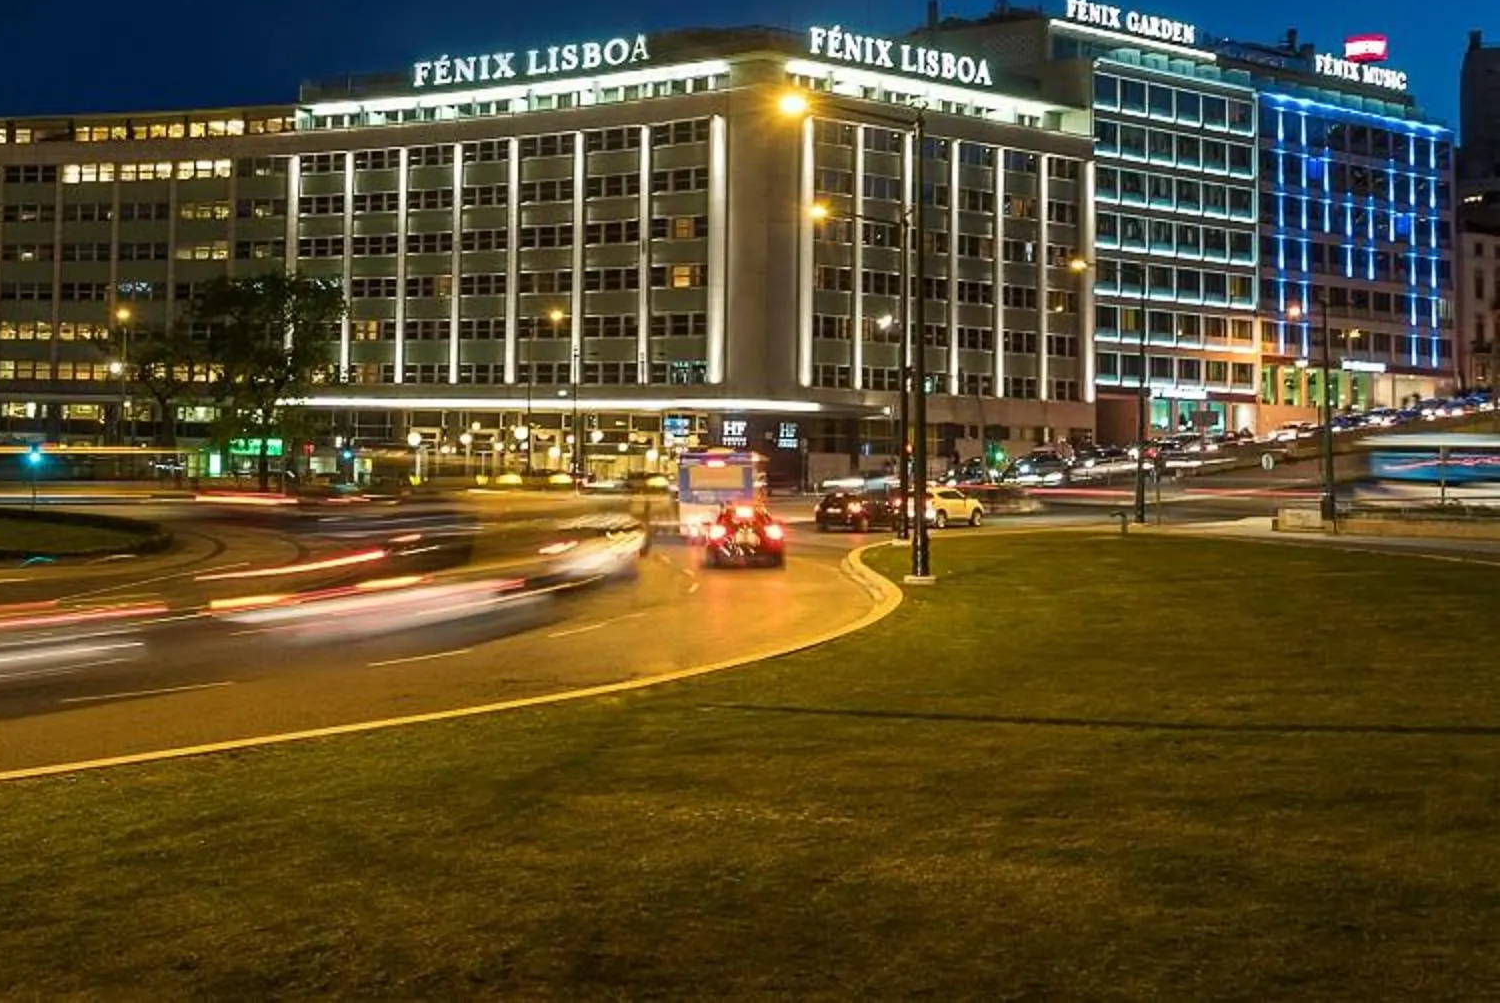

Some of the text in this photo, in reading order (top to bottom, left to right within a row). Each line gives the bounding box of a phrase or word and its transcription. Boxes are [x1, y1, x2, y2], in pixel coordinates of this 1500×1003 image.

[1126, 11, 1195, 44] GARDEN
[413, 33, 649, 87] FÉNIX LISBOA
[809, 25, 992, 86] FÉNIX LISBOA
[723, 421, 747, 436] HF
